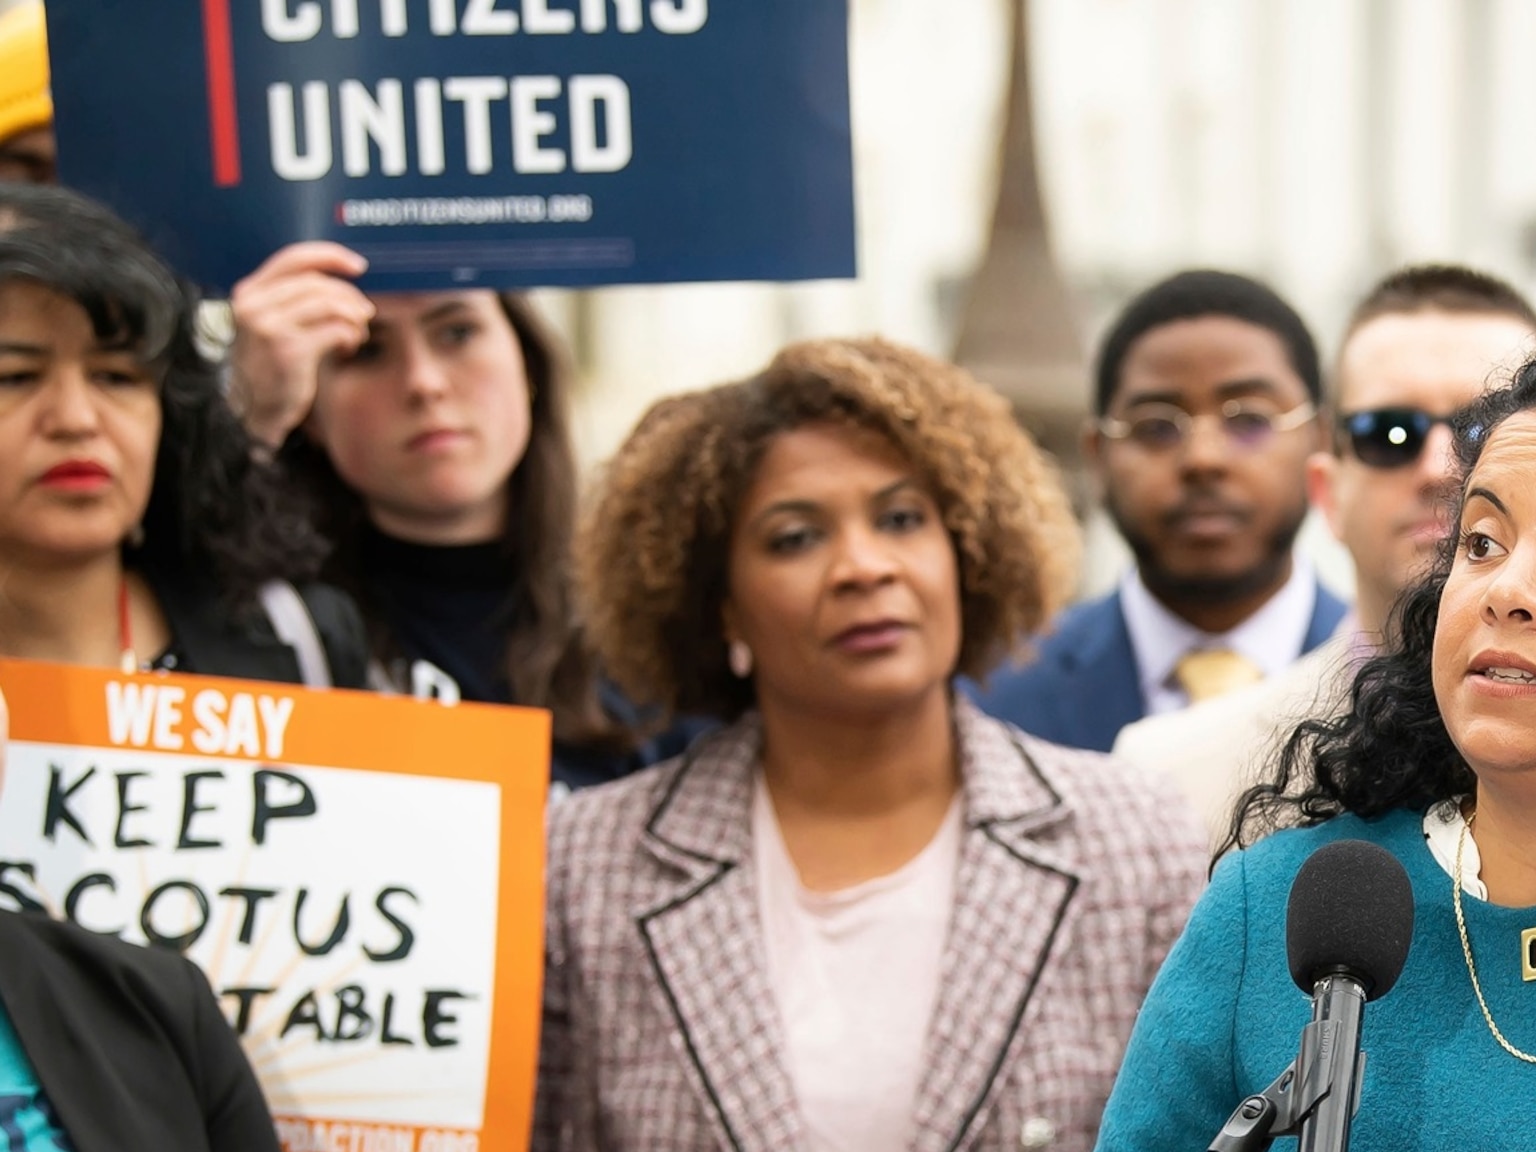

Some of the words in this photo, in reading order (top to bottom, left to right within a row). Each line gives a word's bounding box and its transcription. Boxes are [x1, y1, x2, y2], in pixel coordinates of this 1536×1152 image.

[269, 75, 632, 179] UNITED
[105, 681, 185, 748] WE
[193, 690, 294, 758] SAY
[43, 765, 317, 850] KEEP
[0, 861, 419, 962] SCOTUS
